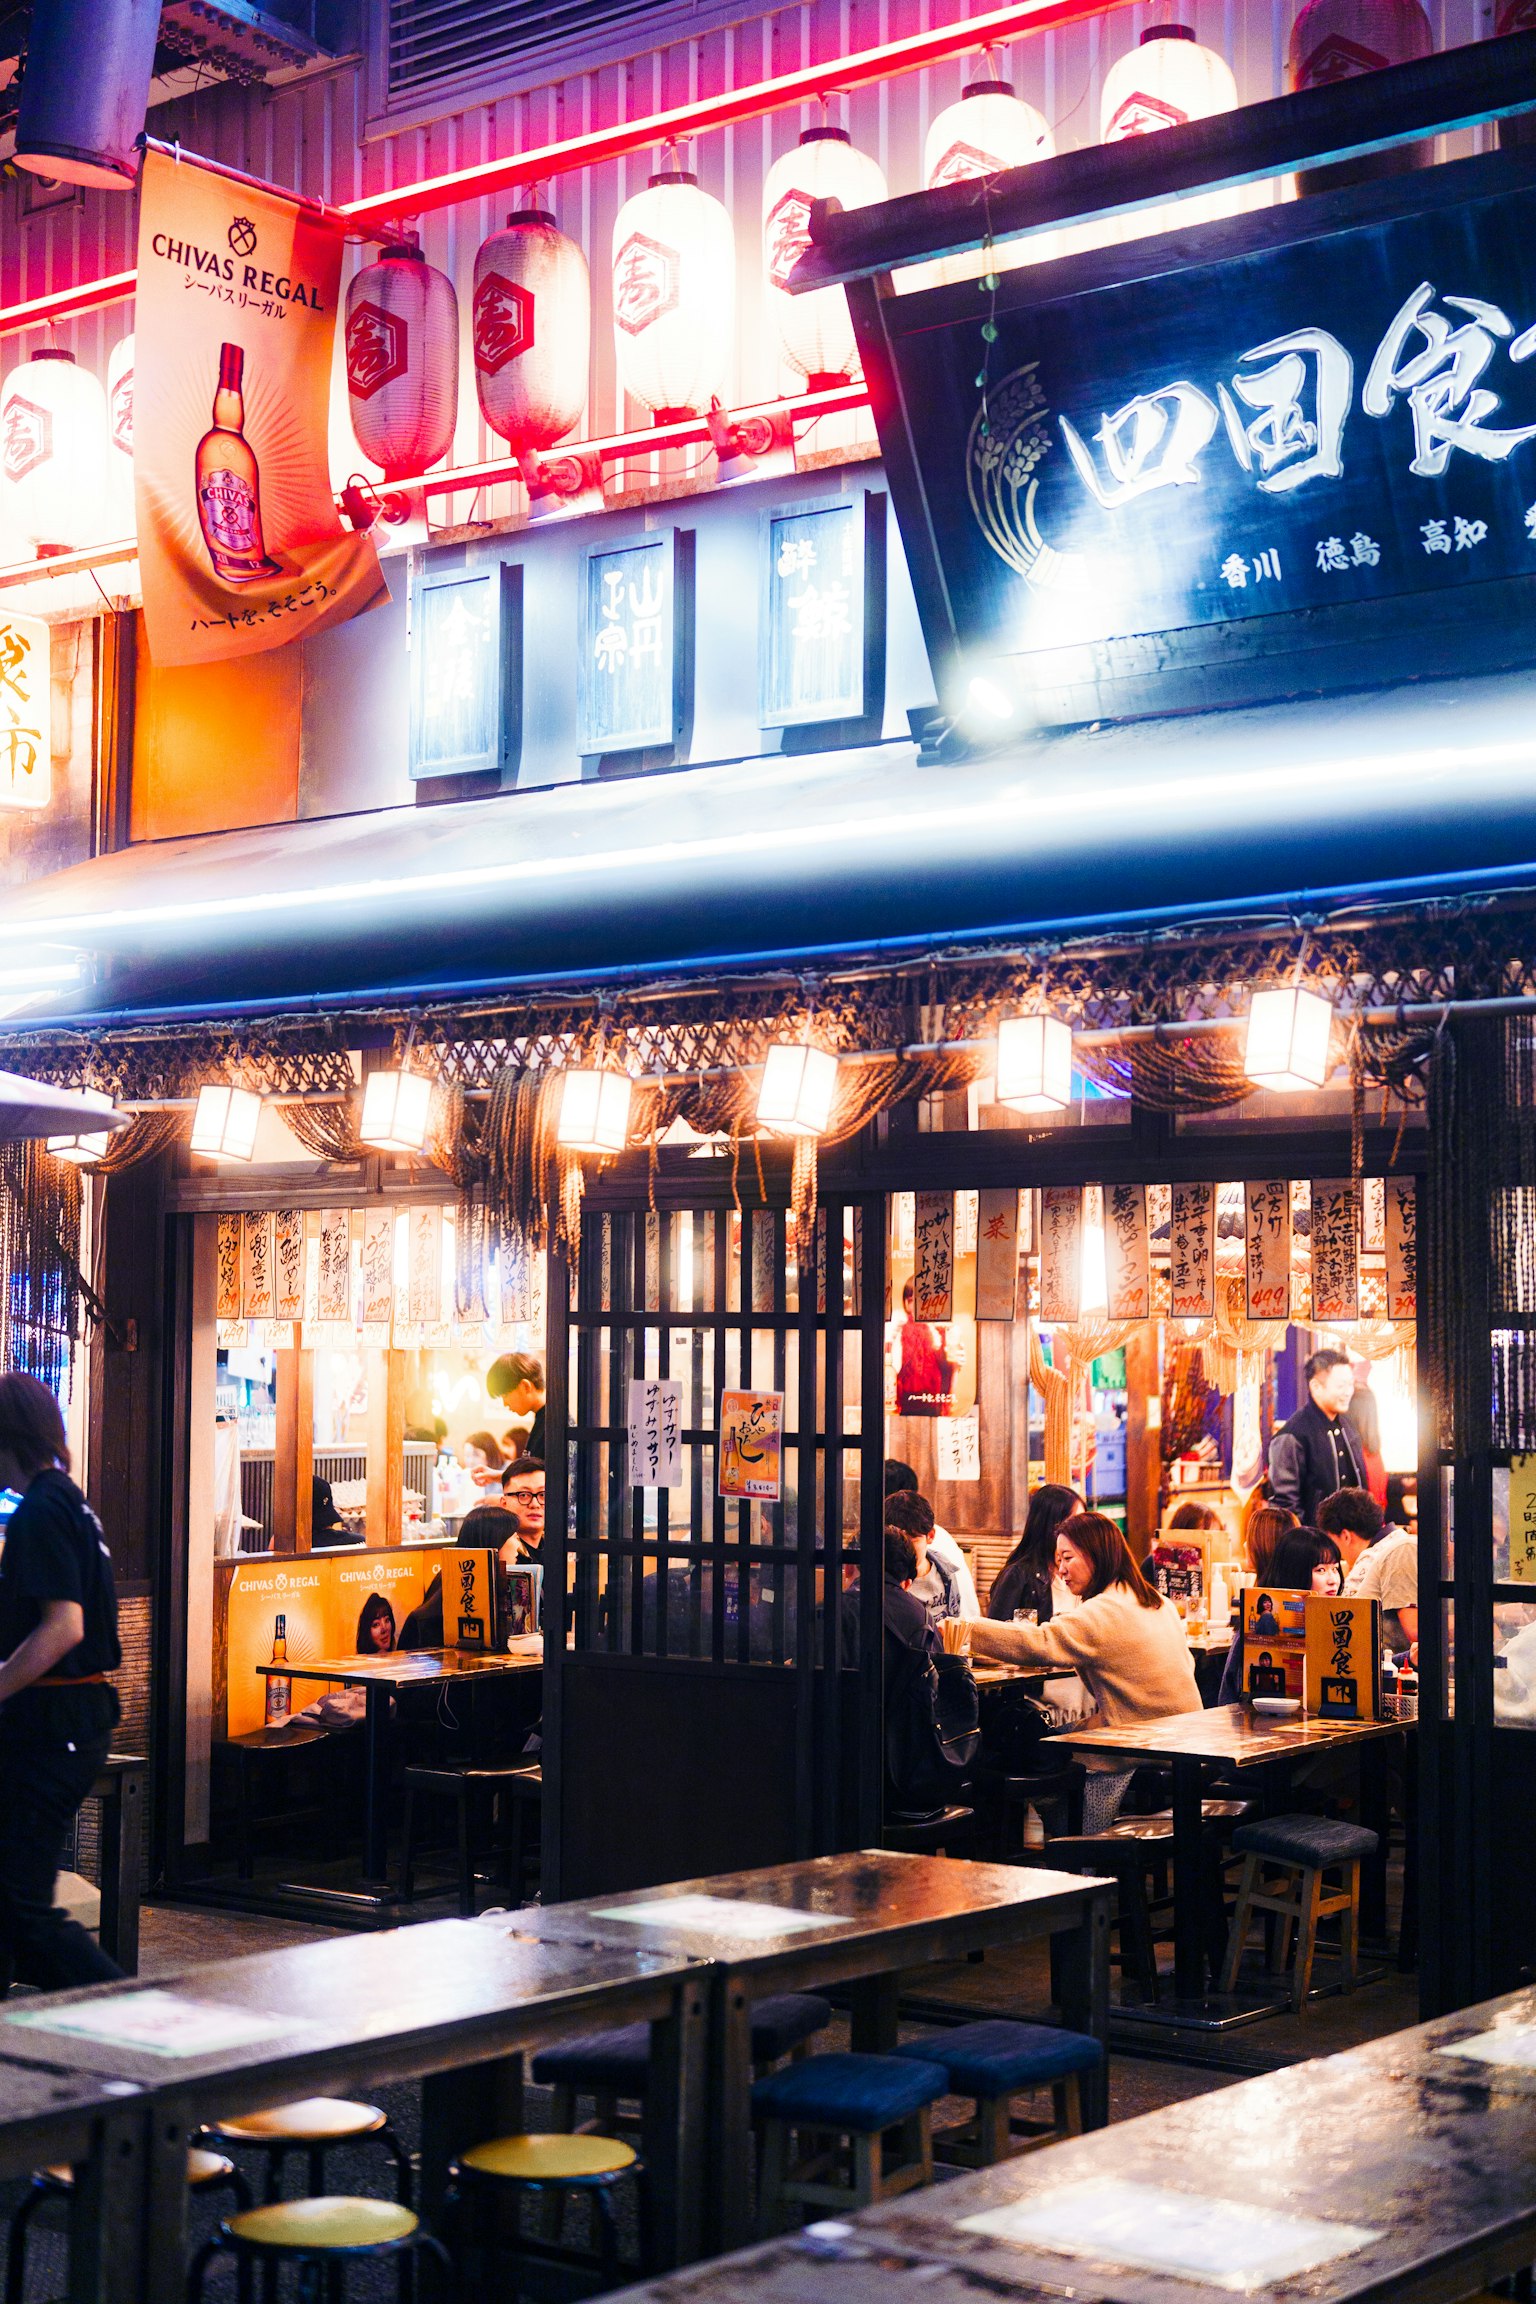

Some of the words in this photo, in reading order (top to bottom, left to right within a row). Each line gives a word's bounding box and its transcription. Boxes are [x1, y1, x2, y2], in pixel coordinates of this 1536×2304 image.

[152, 233, 234, 281] CHIVAS
[242, 264, 324, 312] REGAL
[184, 273, 287, 320] シーバスリーガル
[1057, 280, 1536, 511] 四国食
[206, 486, 251, 508] CHIVAS
[249, 560, 262, 569] 12
[1219, 547, 1282, 590] 香川
[1314, 530, 1382, 574] 徳島
[1418, 515, 1489, 556] 高知
[190, 580, 337, 631] ハートを、そそごう。
[249, 1291, 271, 1309] 699
[1251, 1286, 1284, 1308] 499
[645, 1384, 660, 1480] ゆずみつサワー
[662, 1394, 679, 1466] ゆずサワー
[239, 1578, 274, 1593] CHIVAS
[289, 1575, 320, 1589] REGAL
[339, 1569, 372, 1584] CHIVAS
[386, 1566, 415, 1578] REGAL
